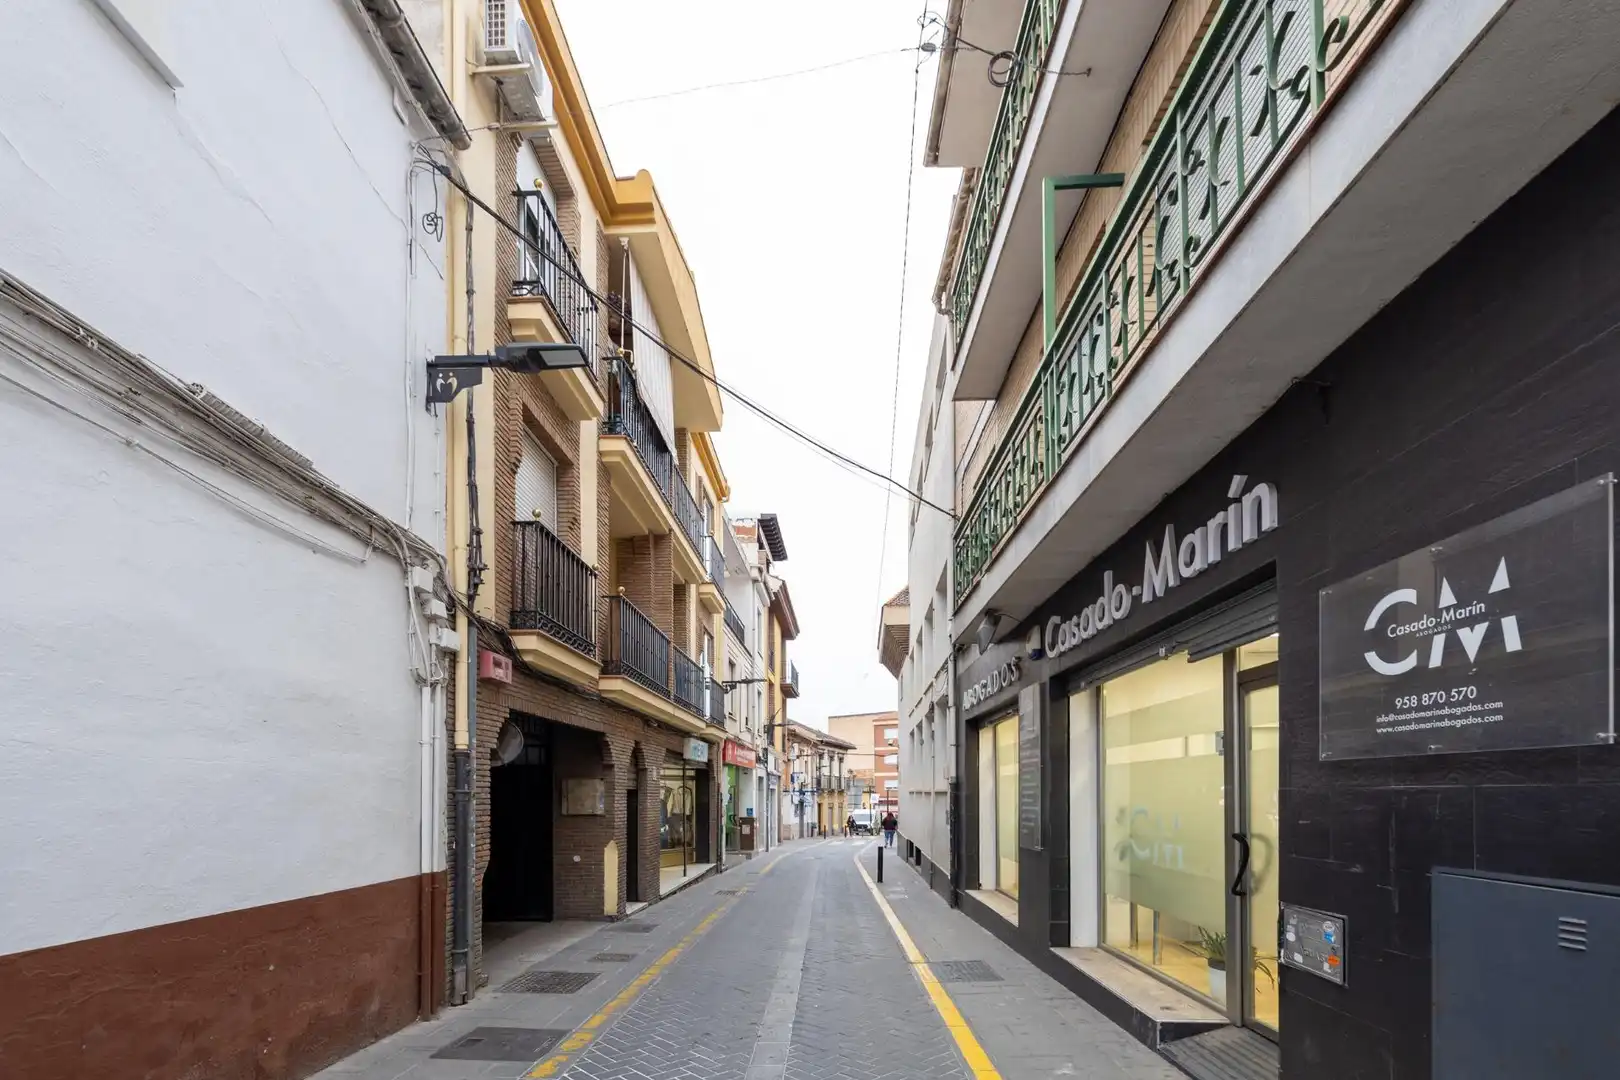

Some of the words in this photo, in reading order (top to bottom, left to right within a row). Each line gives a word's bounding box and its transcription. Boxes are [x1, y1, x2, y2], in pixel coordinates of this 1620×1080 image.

[1044, 475, 1278, 658] Casado-Marín
[962, 656, 1021, 709] ABOGADOS
[1395, 695, 1418, 709] 958
[1421, 690, 1446, 705] 870
[1449, 685, 1477, 701] 570
[1376, 701, 1504, 723] info@casadomarinabogados.com
[1376, 714, 1504, 733] www.casadomarinabogados.com
